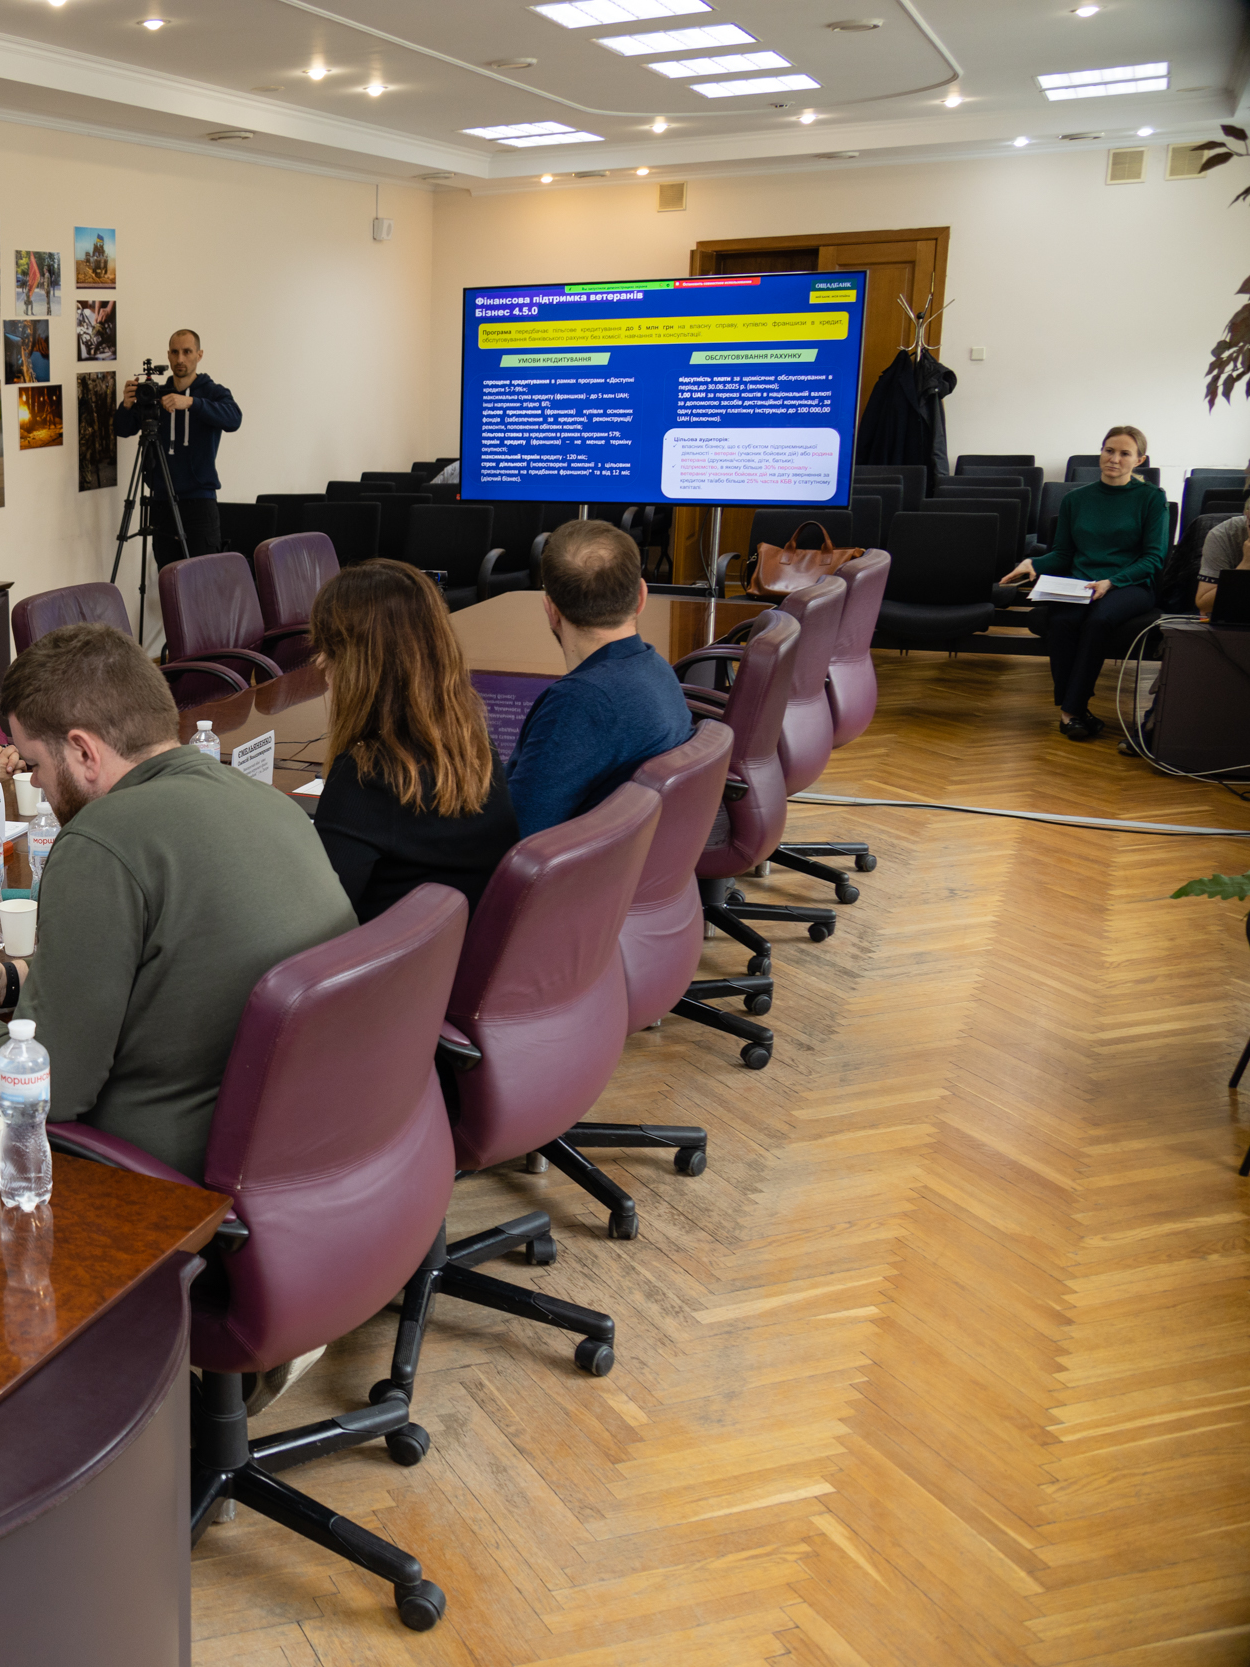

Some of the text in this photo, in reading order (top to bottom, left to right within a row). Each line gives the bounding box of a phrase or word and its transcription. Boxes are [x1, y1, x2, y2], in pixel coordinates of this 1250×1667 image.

[815, 281, 851, 289] ОЩАДБАНК
[476, 291, 643, 306] Фінансова підтримка ветеранів
[476, 306, 538, 317] Бізнес 4.5.0
[482, 329, 512, 337] Програма
[581, 326, 622, 334] кредитування
[743, 321, 768, 329] купівлю
[543, 356, 591, 364] КРЕДИТУВАННЯ
[0, 1072, 50, 1086] моршинс
